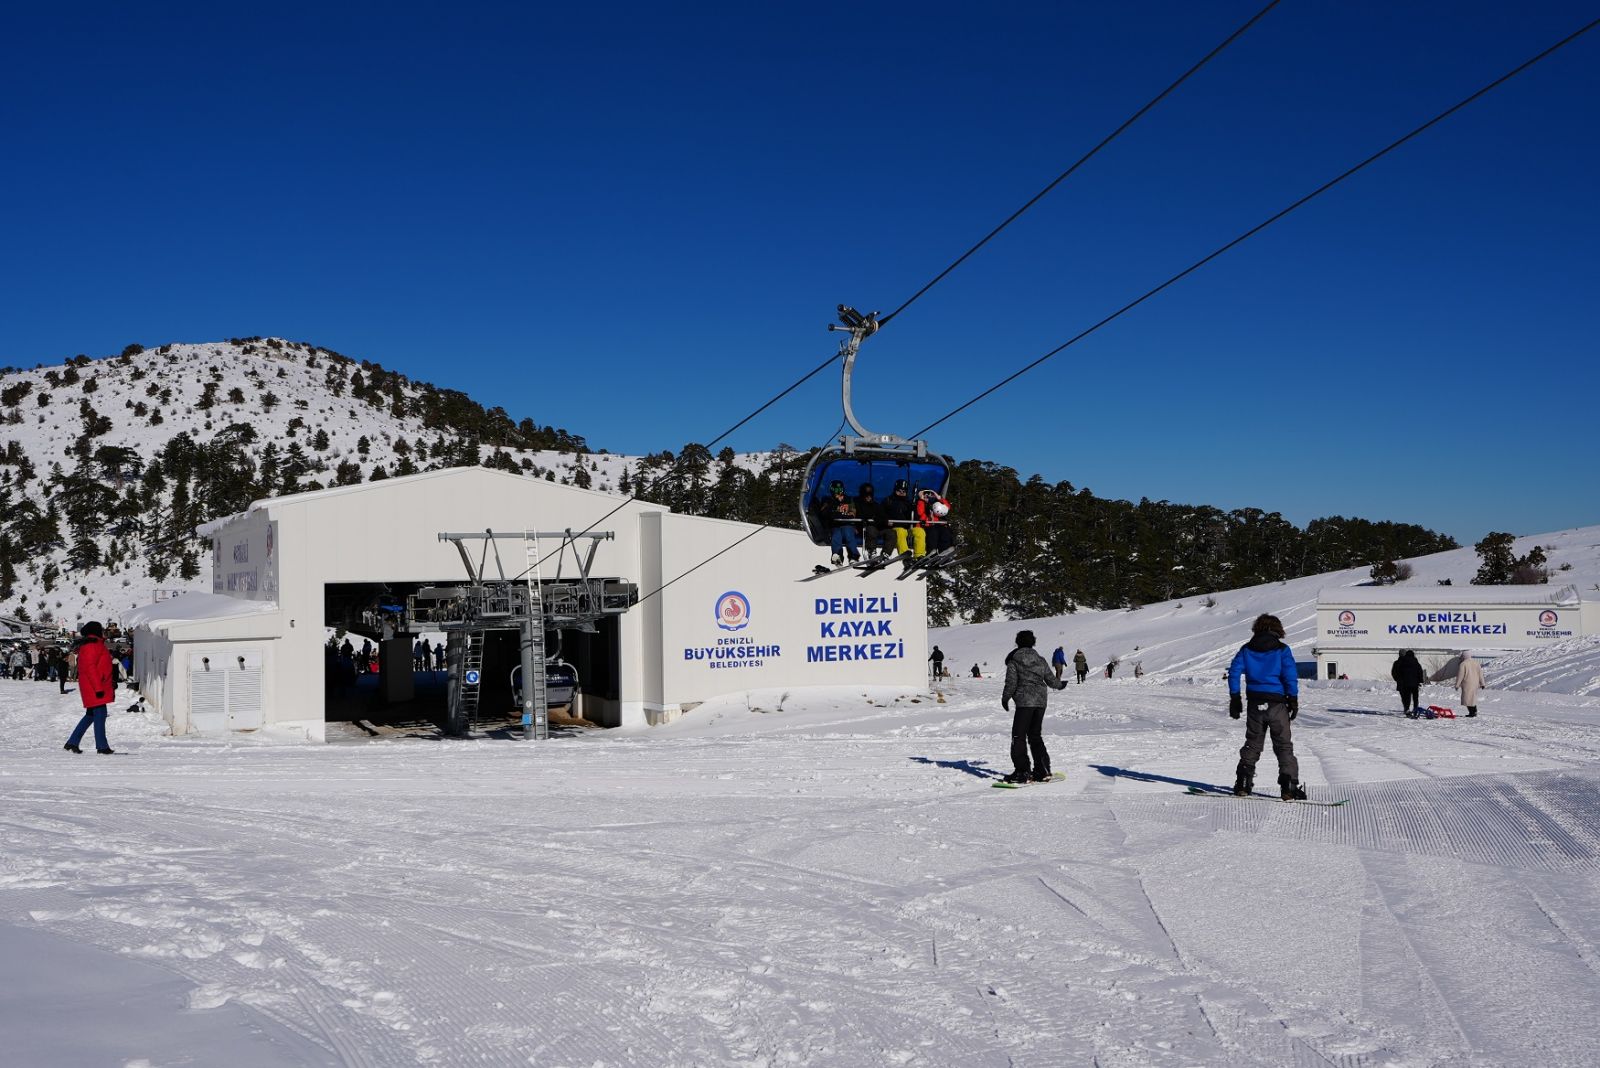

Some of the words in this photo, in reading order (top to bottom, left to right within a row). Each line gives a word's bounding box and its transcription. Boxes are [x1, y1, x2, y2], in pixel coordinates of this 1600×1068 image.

[815, 593, 898, 615] DENİZLİ
[1417, 612, 1477, 623] DENİZLİ
[820, 620, 892, 638] KAYAK
[1388, 625, 1436, 635] KAYAK
[1439, 623, 1507, 635] MERKEZİ
[807, 638, 904, 662] MERKEZİ
